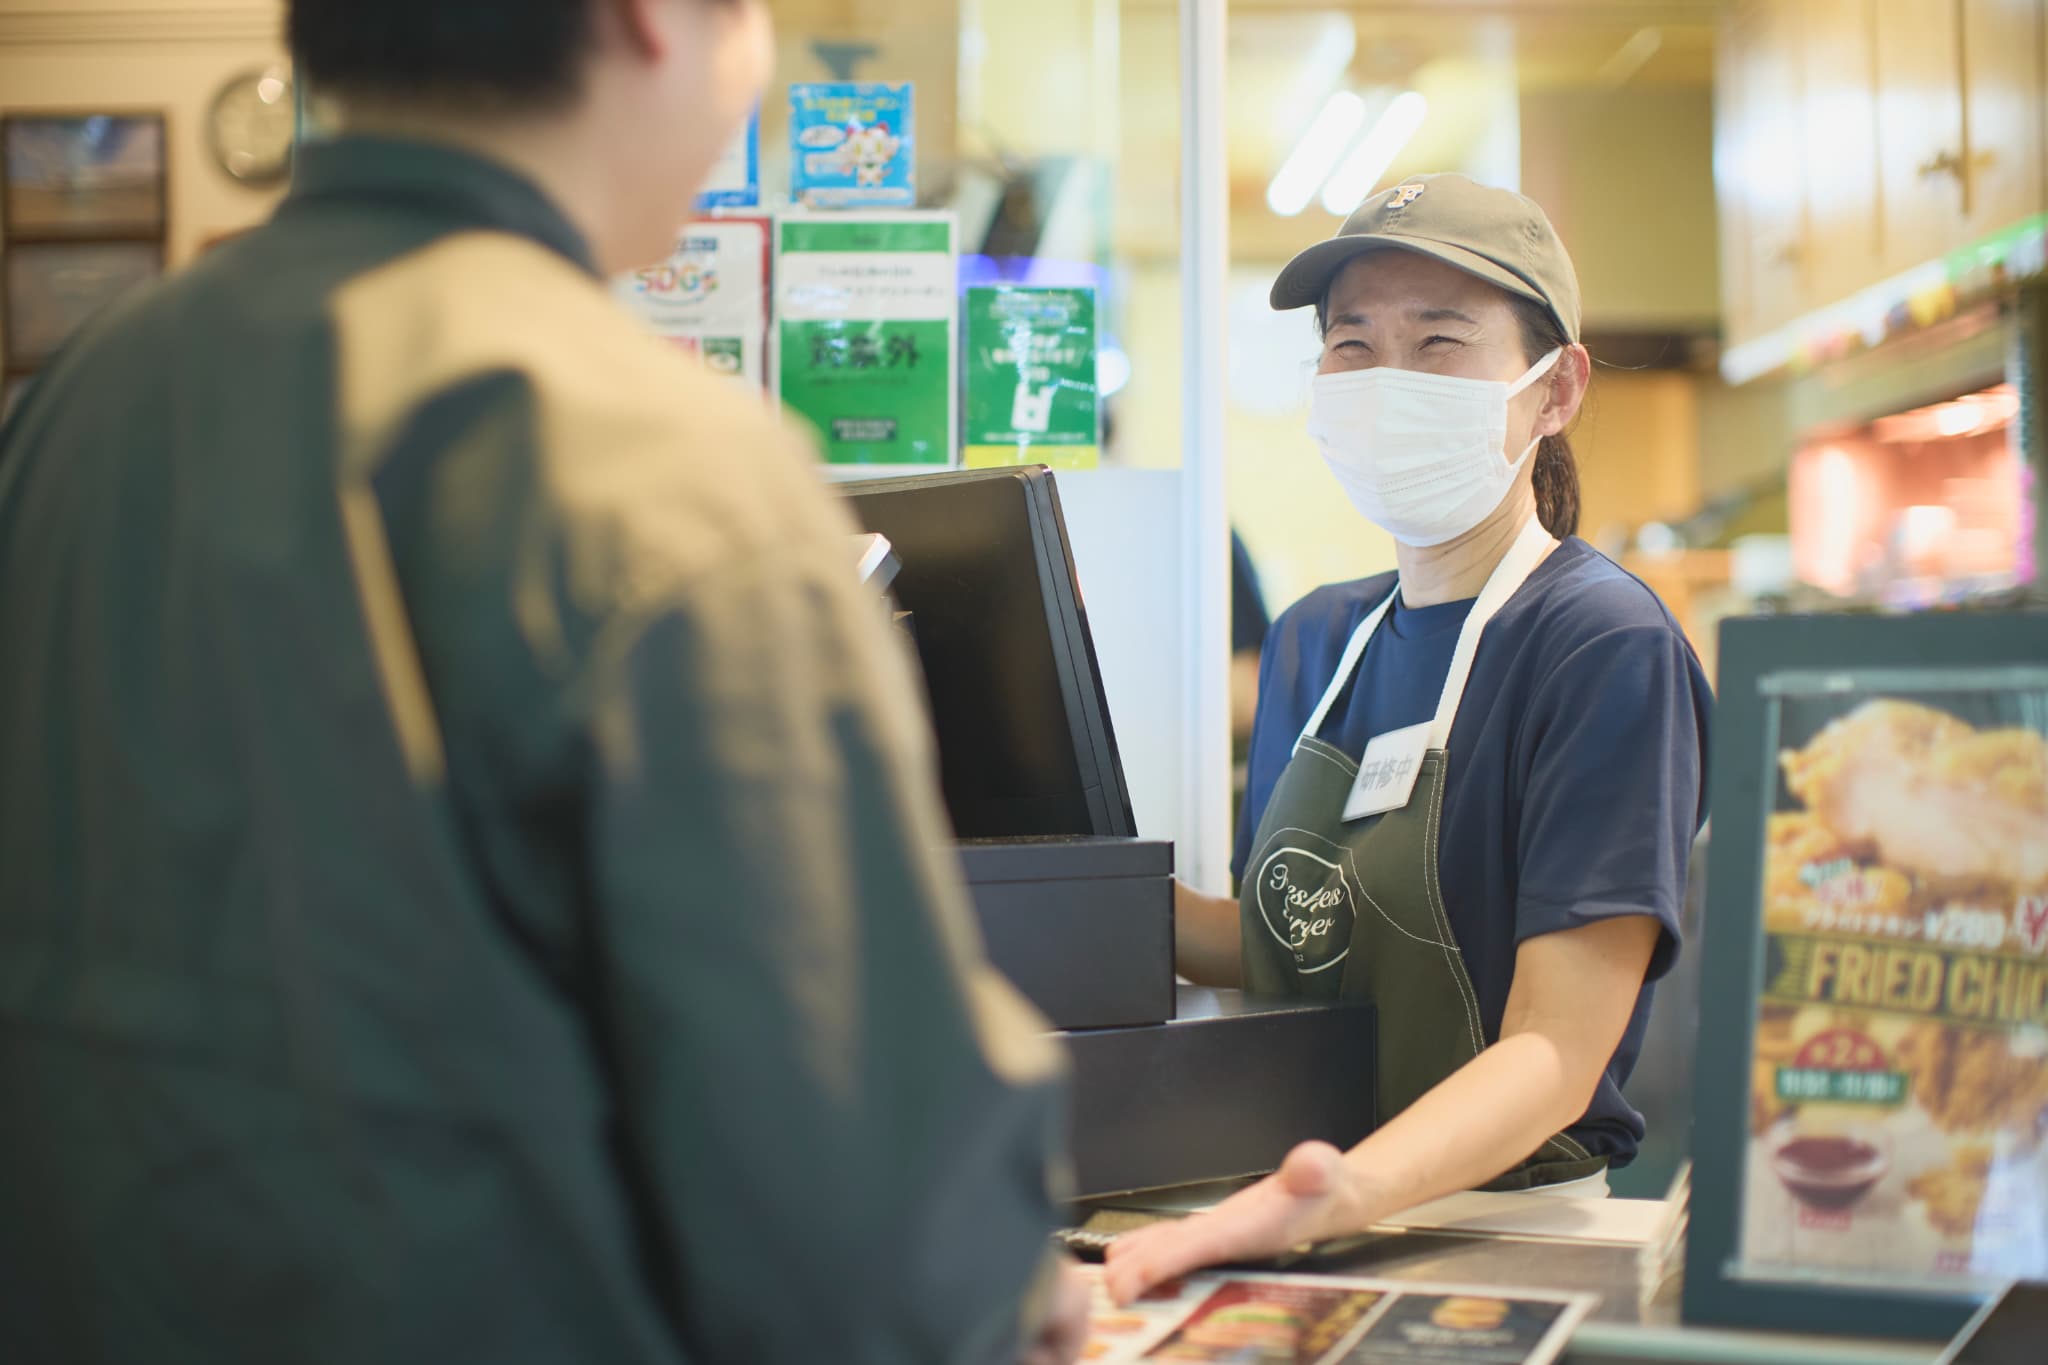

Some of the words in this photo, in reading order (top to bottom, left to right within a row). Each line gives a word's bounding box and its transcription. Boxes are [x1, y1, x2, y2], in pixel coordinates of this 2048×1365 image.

[1385, 184, 1425, 210] F
[635, 263, 720, 294] SDGs
[809, 332, 920, 369] 対象外
[1361, 753, 1413, 792] 研修中
[1808, 943, 1944, 1013] FRIED
